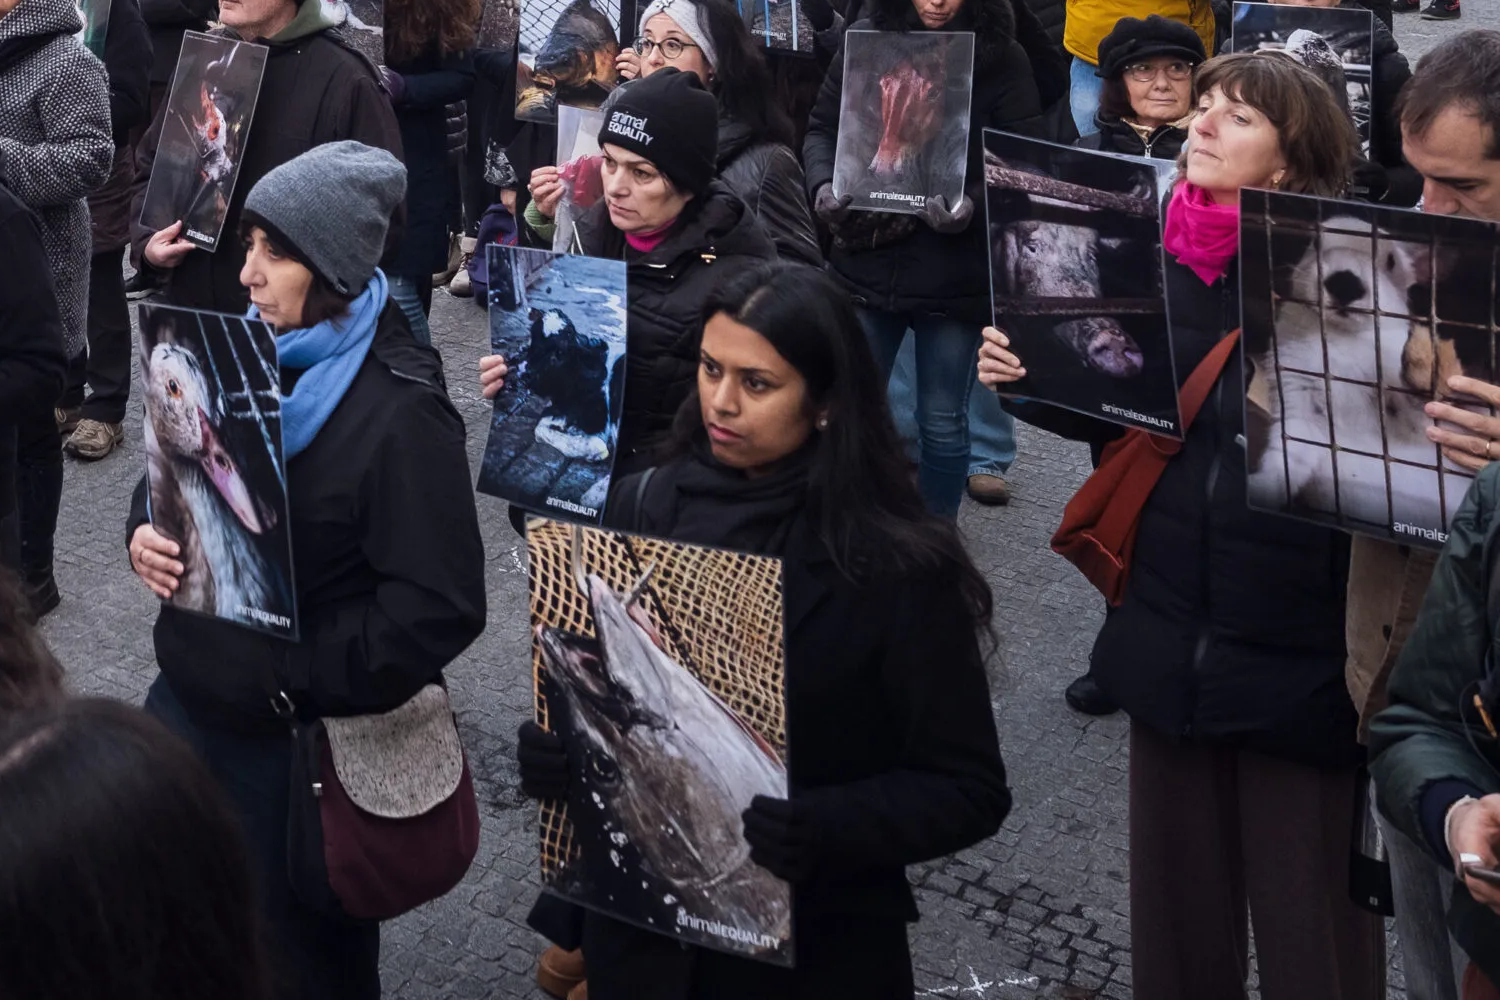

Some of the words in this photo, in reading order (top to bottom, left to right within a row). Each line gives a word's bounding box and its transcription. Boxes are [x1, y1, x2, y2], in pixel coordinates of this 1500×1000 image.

[611, 110, 648, 131] animal
[608, 120, 654, 146] EQUALITY
[870, 190, 926, 203] animalEQUALITY
[1101, 402, 1175, 430] animalEQUALITY
[545, 495, 598, 518] animalEQUALITY
[677, 912, 781, 951] animalEQUALITY
